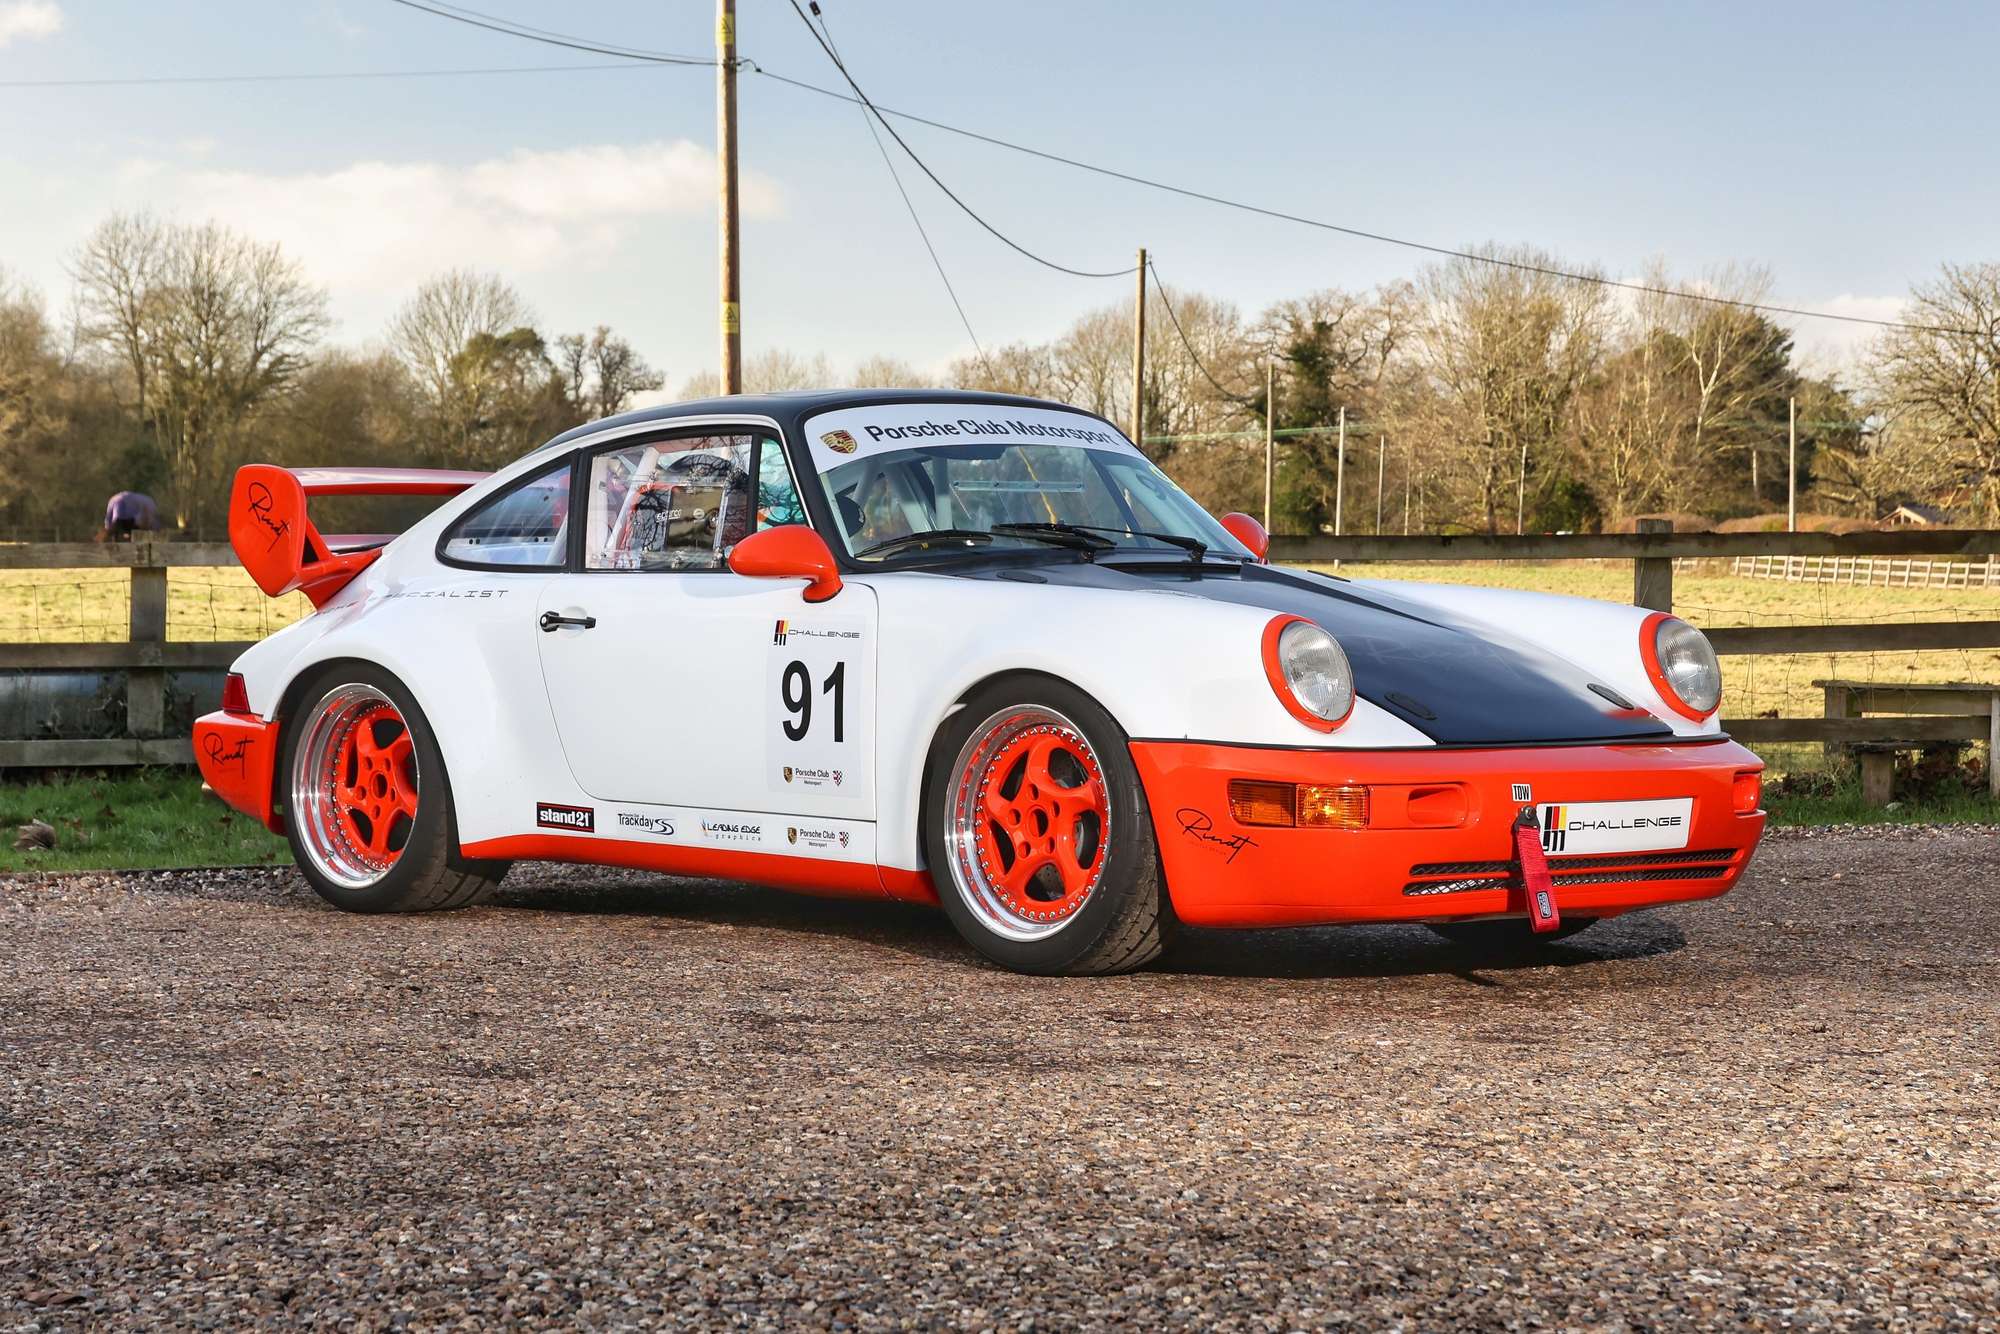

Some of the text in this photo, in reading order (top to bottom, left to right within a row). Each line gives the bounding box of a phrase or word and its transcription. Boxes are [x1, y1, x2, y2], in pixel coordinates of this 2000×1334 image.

[864, 419, 1119, 446] Porsche Club Motorsport
[788, 629, 860, 638] CHALLENGE
[782, 660, 845, 742] 91
[795, 767, 829, 778] Porsche Club
[1513, 785, 1530, 800] TOW
[540, 809, 589, 828] stand21
[618, 813, 655, 830] Trackday
[1568, 816, 1682, 831] CHALLENGE
[741, 825, 761, 834] EDGE
[800, 829, 835, 840] Porsche Club
